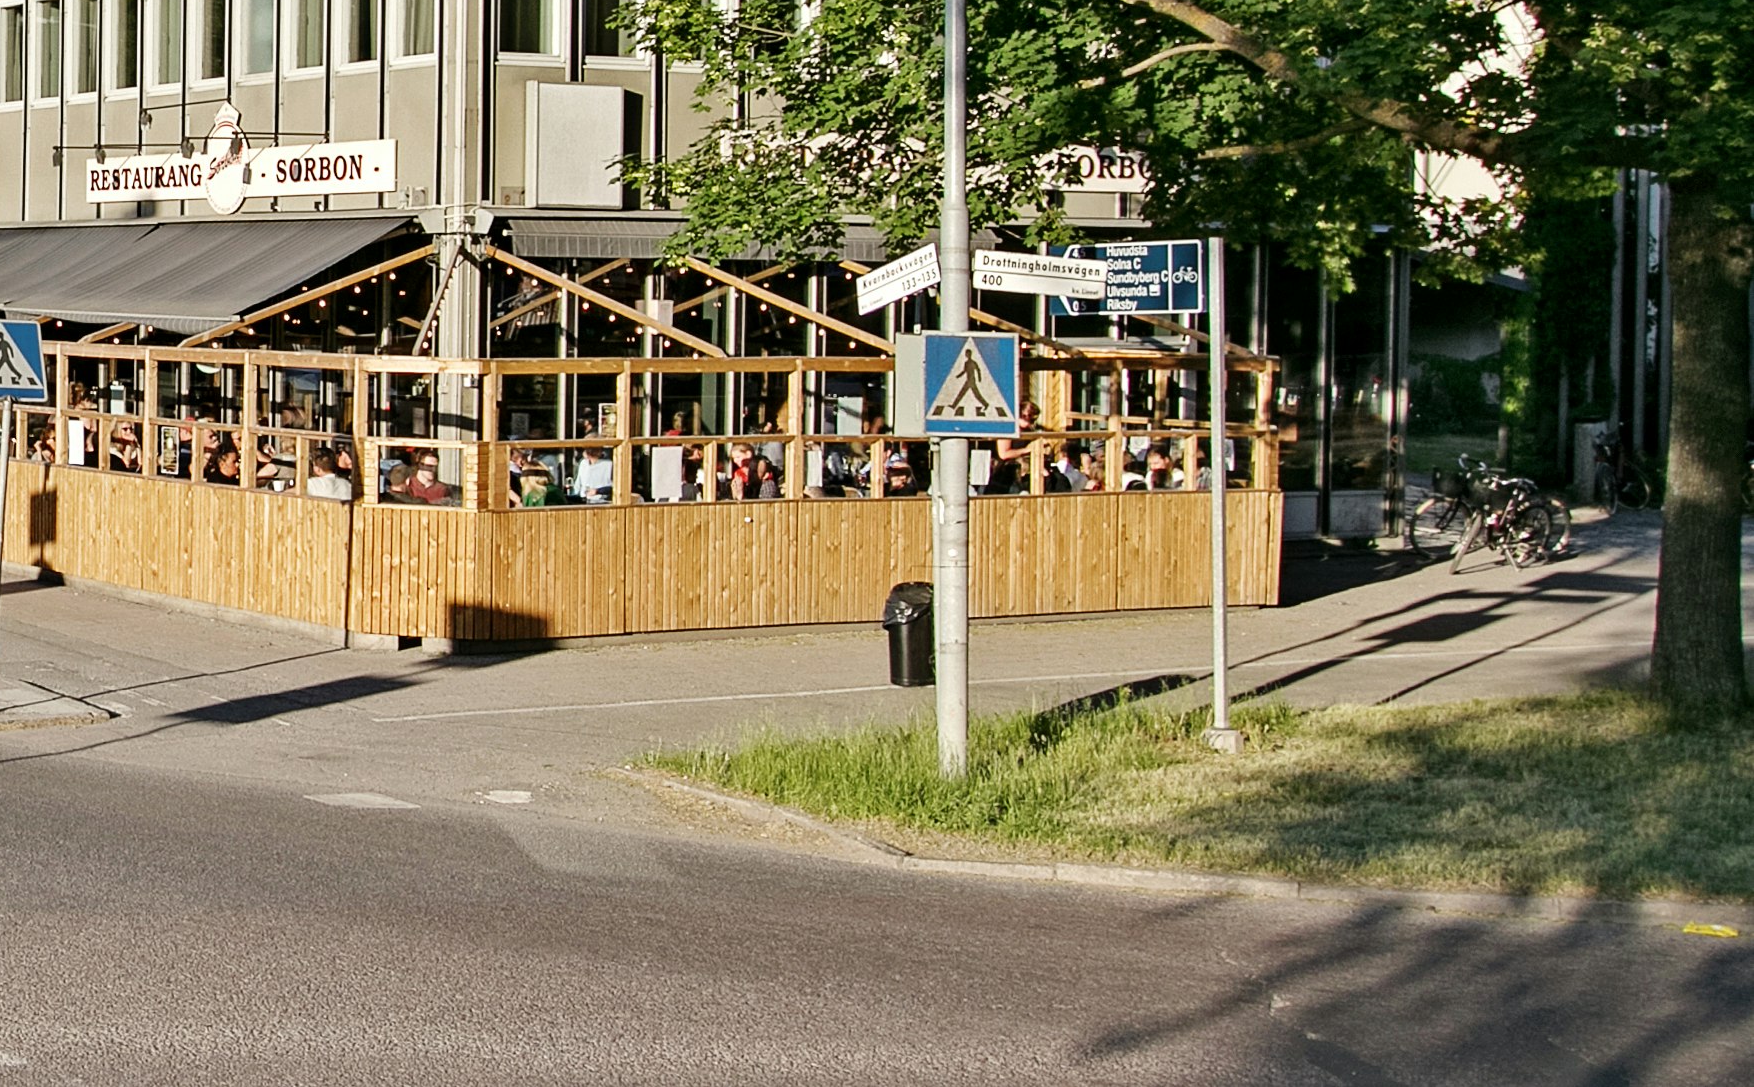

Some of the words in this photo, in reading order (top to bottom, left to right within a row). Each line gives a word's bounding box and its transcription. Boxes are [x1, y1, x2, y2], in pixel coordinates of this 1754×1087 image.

[90, 165, 202, 191] RESTAURANG
[1106, 245, 1148, 256] Huvudsta
[983, 255, 1100, 278] Drottningholmsvägen
[1106, 259, 1132, 270] Solna
[1133, 258, 1142, 269] C
[901, 268, 937, 292] 133-135
[981, 274, 1003, 286] 400
[1106, 272, 1160, 285] Sundbyberg
[1160, 270, 1168, 282] C
[1106, 285, 1147, 298] Ulvsunda
[1106, 299, 1138, 311] Riksby
